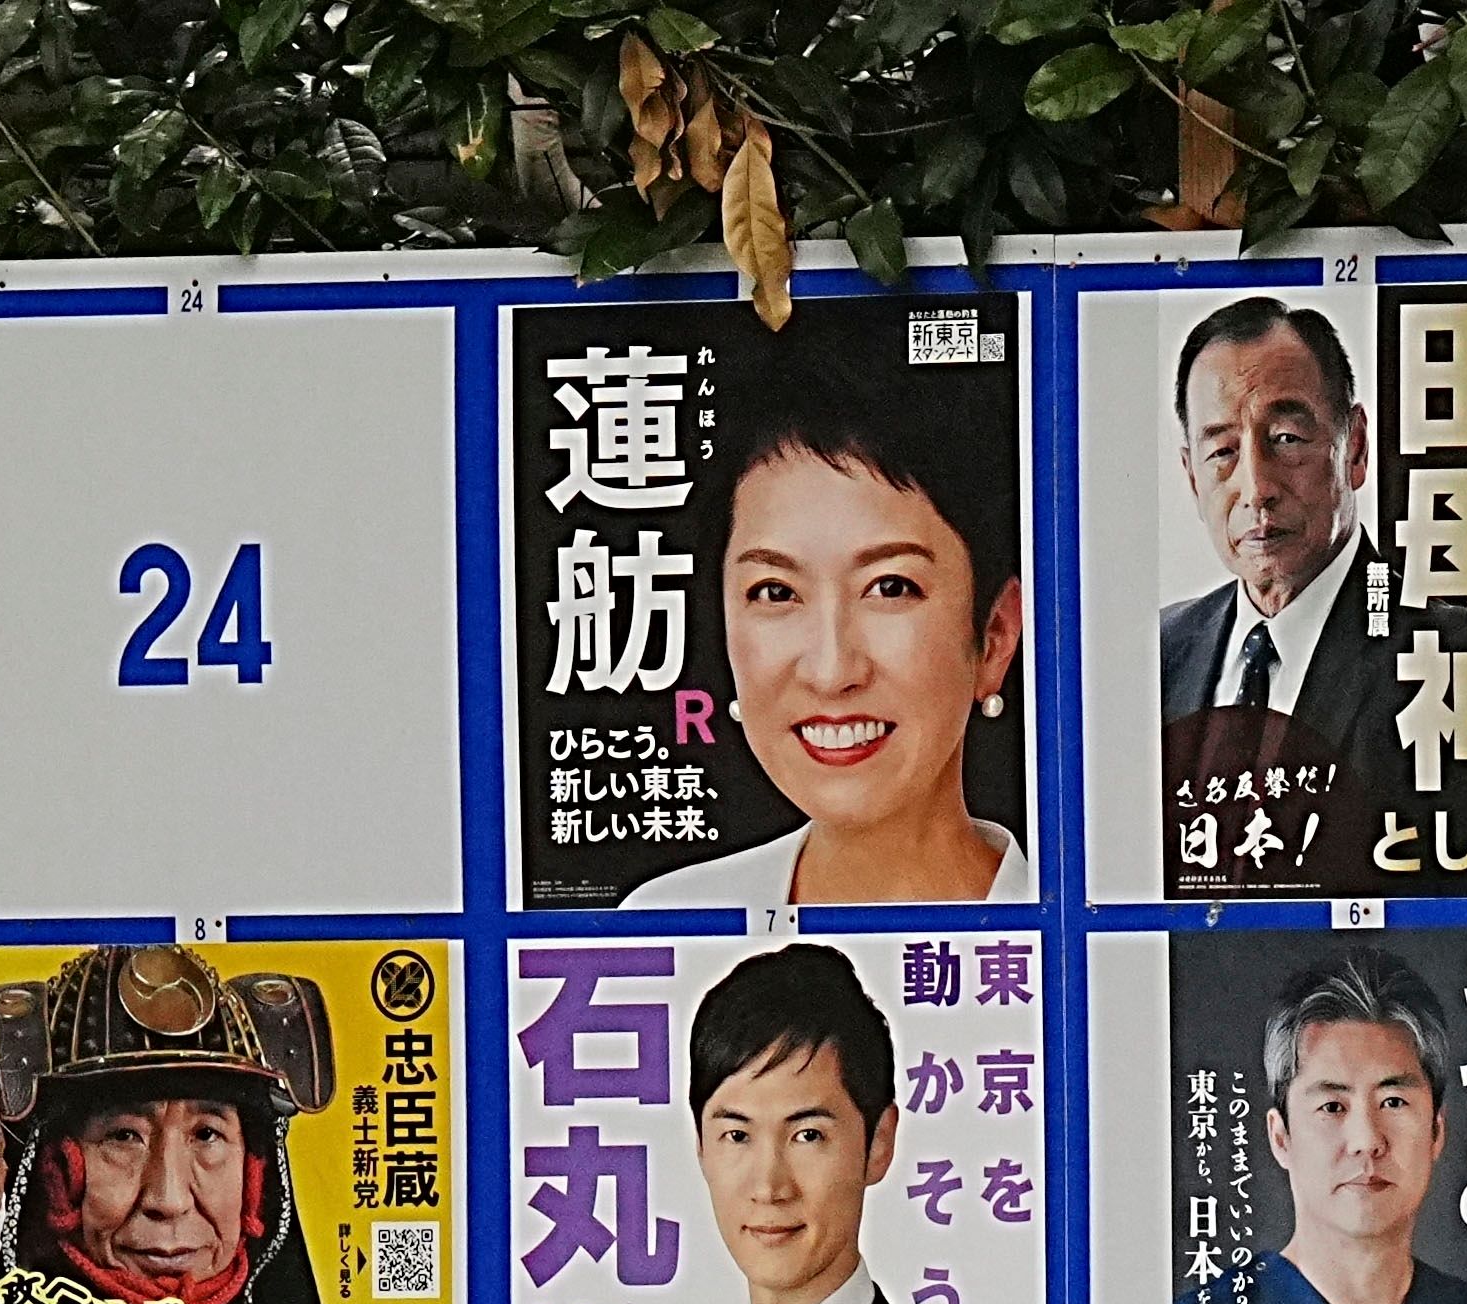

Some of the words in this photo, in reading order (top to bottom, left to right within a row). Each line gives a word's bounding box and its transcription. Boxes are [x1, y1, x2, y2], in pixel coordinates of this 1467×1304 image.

[913, 323, 974, 346] 新東京
[913, 347, 974, 361] スタンダード
[697, 346, 716, 461] れんほう
[545, 345, 694, 696] 蓮舫
[121, 546, 271, 685] 24
[1366, 562, 1390, 637] 無所属
[550, 727, 669, 761] ひらこう。
[676, 690, 714, 744] R
[551, 765, 719, 802] 新しい東京、
[551, 807, 720, 843] 新しい未来。
[766, 910, 775, 932] 7
[382, 1029, 439, 1208] 忠臣蔵
[975, 940, 1034, 1223] 東京を
[351, 1084, 379, 1209] 義士新党
[338, 1223, 352, 1299] 詳しく見る
